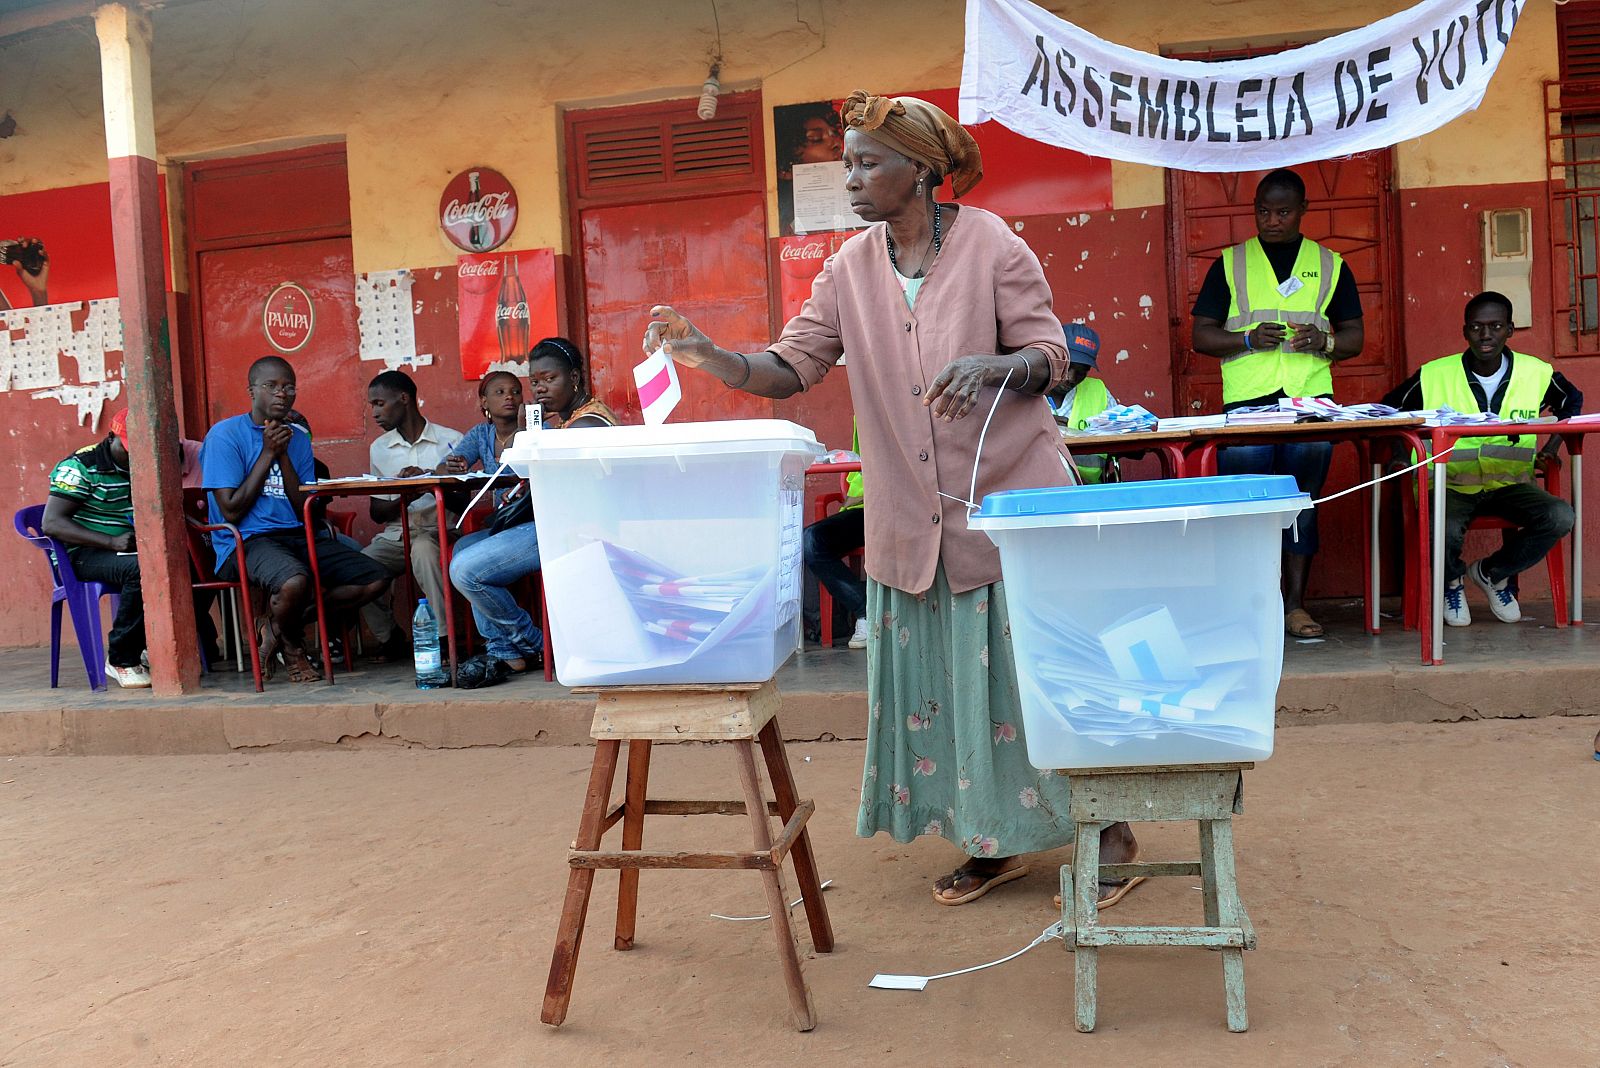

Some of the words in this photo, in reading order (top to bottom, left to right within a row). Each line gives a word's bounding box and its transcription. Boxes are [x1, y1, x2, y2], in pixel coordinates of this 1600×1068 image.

[1021, 35, 1313, 142] ASSEMBLEIA
[1334, 46, 1392, 130] DE
[268, 311, 309, 330] PAMPA
